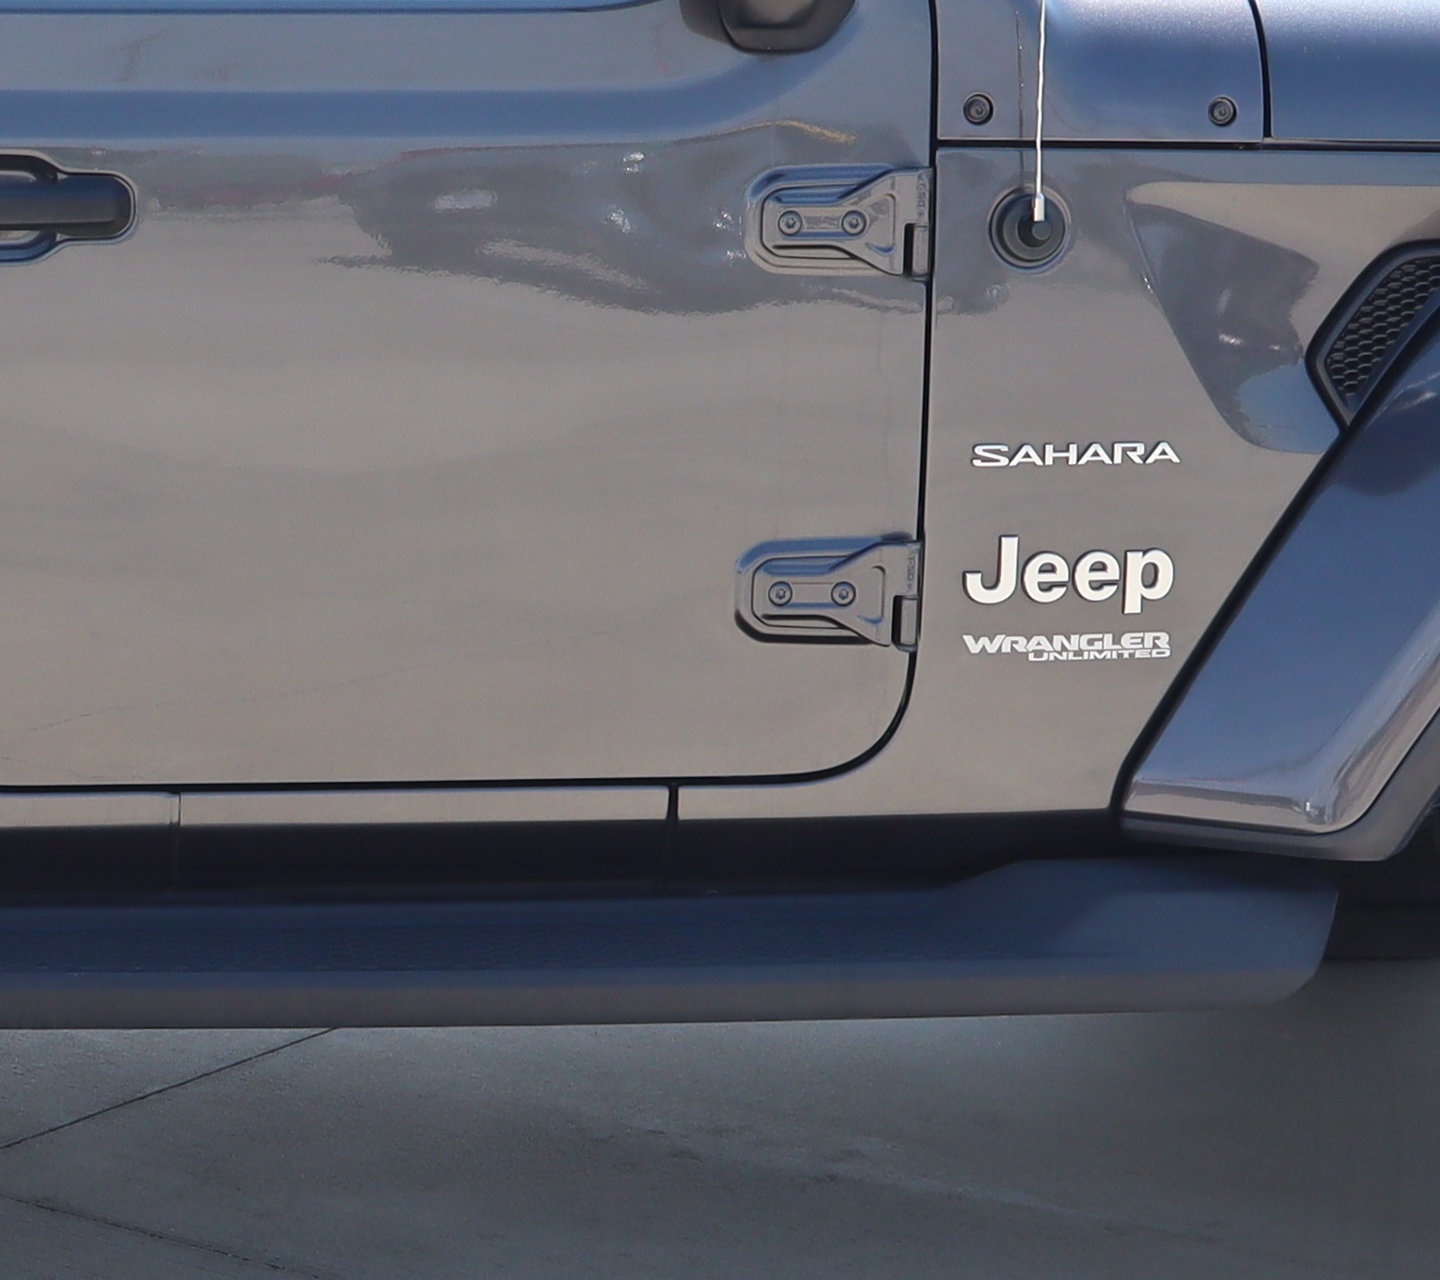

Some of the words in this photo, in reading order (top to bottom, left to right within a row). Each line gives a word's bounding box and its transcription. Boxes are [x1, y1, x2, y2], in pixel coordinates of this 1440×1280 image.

[971, 441, 1181, 468] SAHARA
[963, 534, 1175, 615] Jeep
[963, 631, 1172, 655] WRANGLER
[1027, 648, 1171, 662] UNLIMITED
